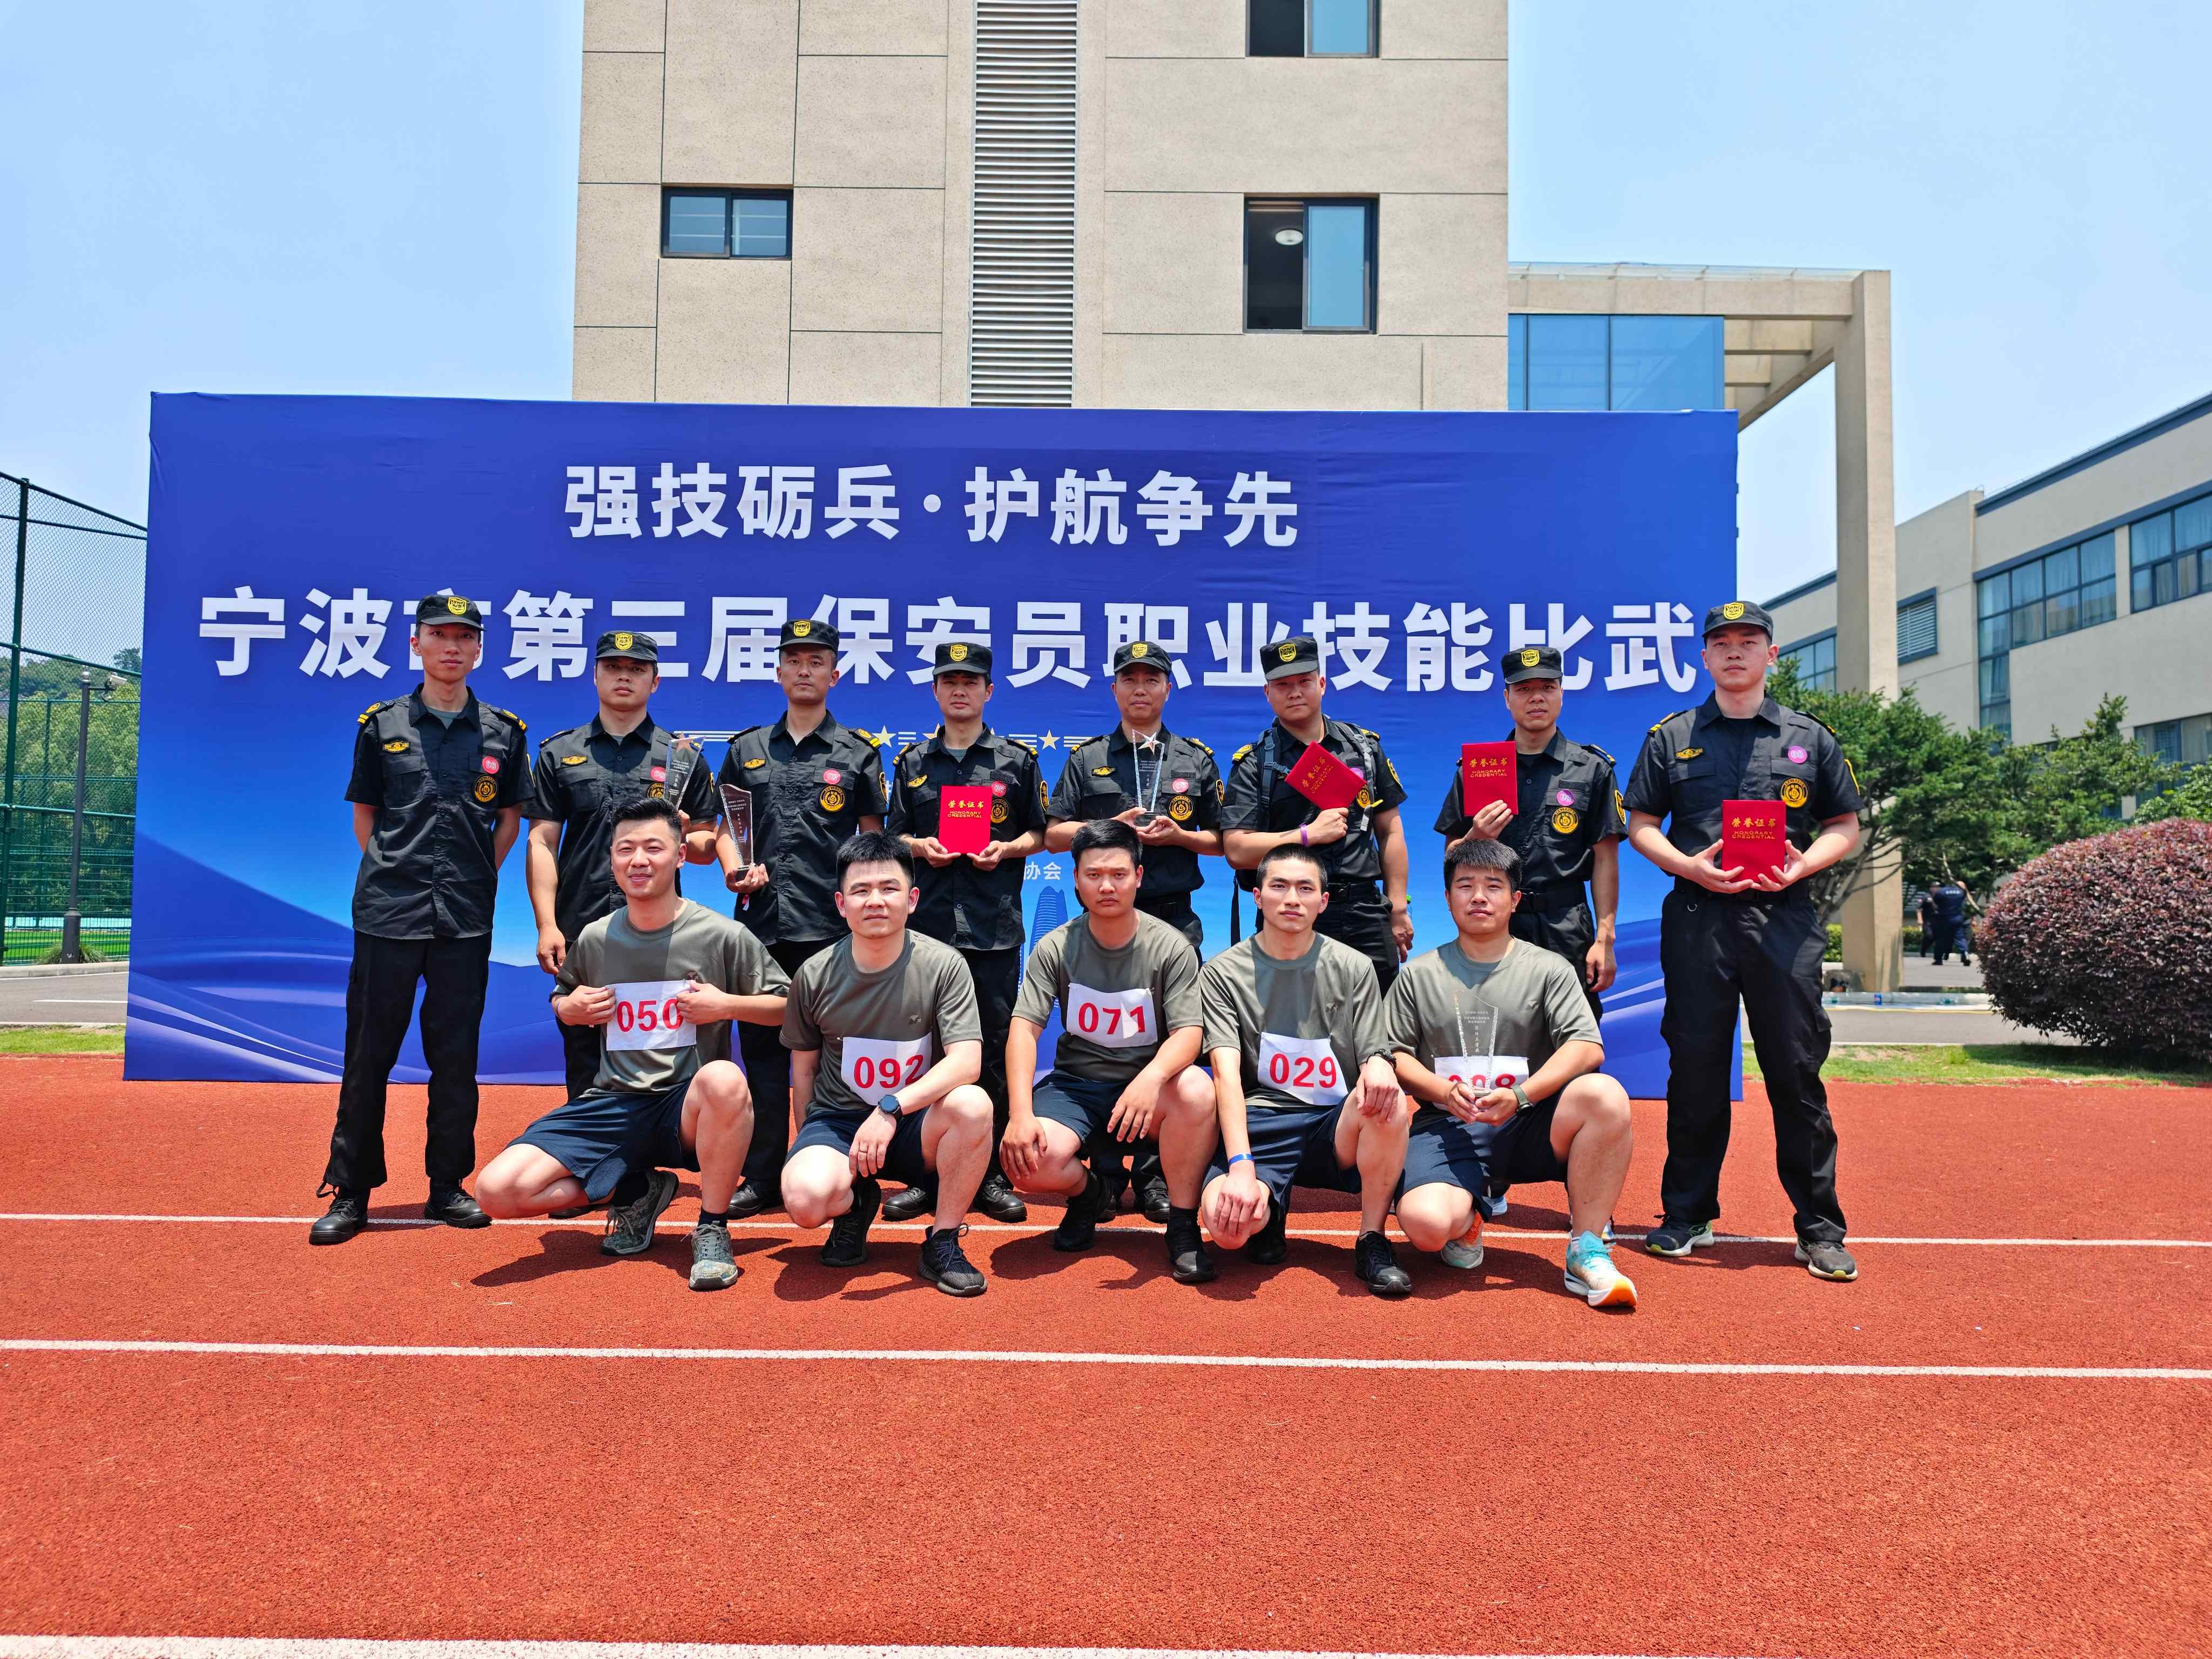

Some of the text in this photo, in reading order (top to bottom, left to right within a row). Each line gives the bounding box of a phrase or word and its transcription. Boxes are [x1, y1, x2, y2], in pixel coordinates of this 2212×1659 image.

[565, 462, 1297, 547] 强技砺兵·护航争先
[1469, 758, 1507, 767] 荣誉证书
[948, 800, 984, 809] 荣誉证书
[1731, 817, 1776, 828] 荣誉证书
[616, 999, 684, 1033] 050
[1078, 1002, 1145, 1035] 071
[854, 1054, 923, 1089] 092
[1270, 1054, 1337, 1088] 029
